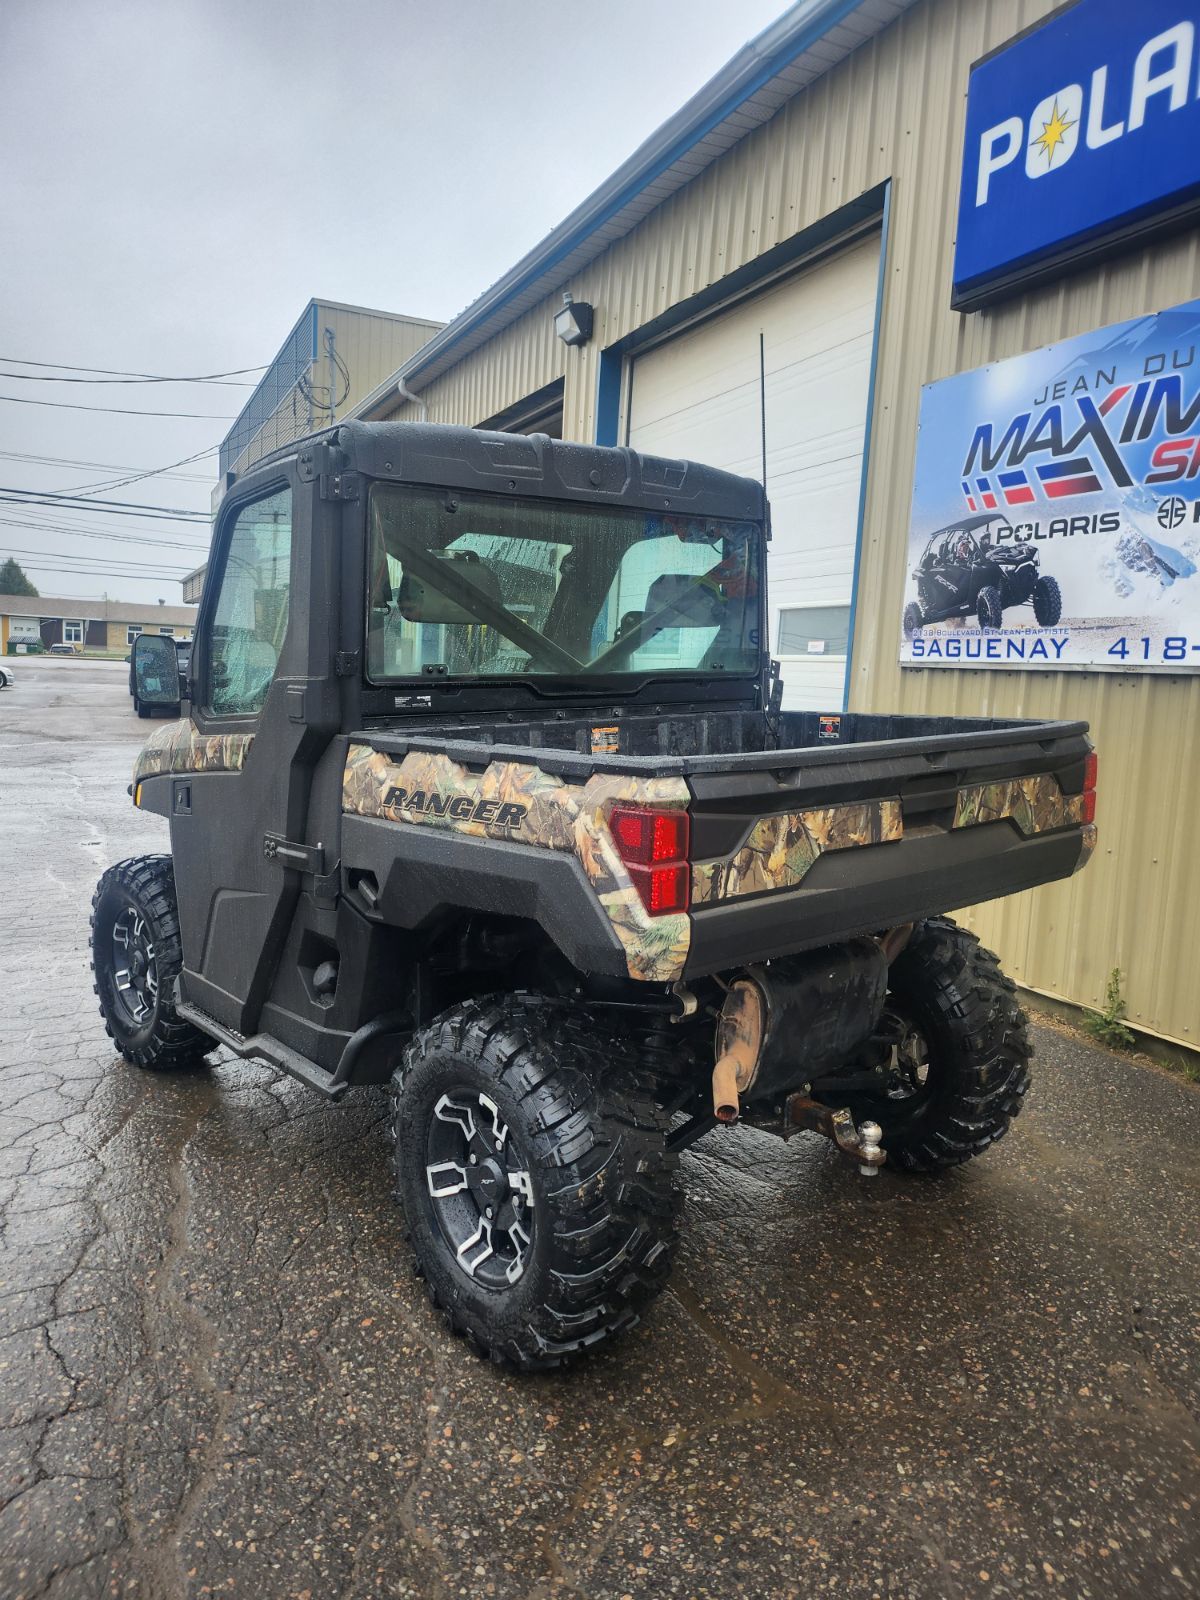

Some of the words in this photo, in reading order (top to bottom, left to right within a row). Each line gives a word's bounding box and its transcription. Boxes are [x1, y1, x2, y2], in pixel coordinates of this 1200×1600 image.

[975, 20, 1200, 208] POLA
[1034, 365, 1116, 406] JEAN
[1144, 437, 1200, 485] S
[996, 511, 1120, 545] POLARIS
[912, 638, 1070, 659] SAGUENAY
[382, 786, 529, 829] RANGER
